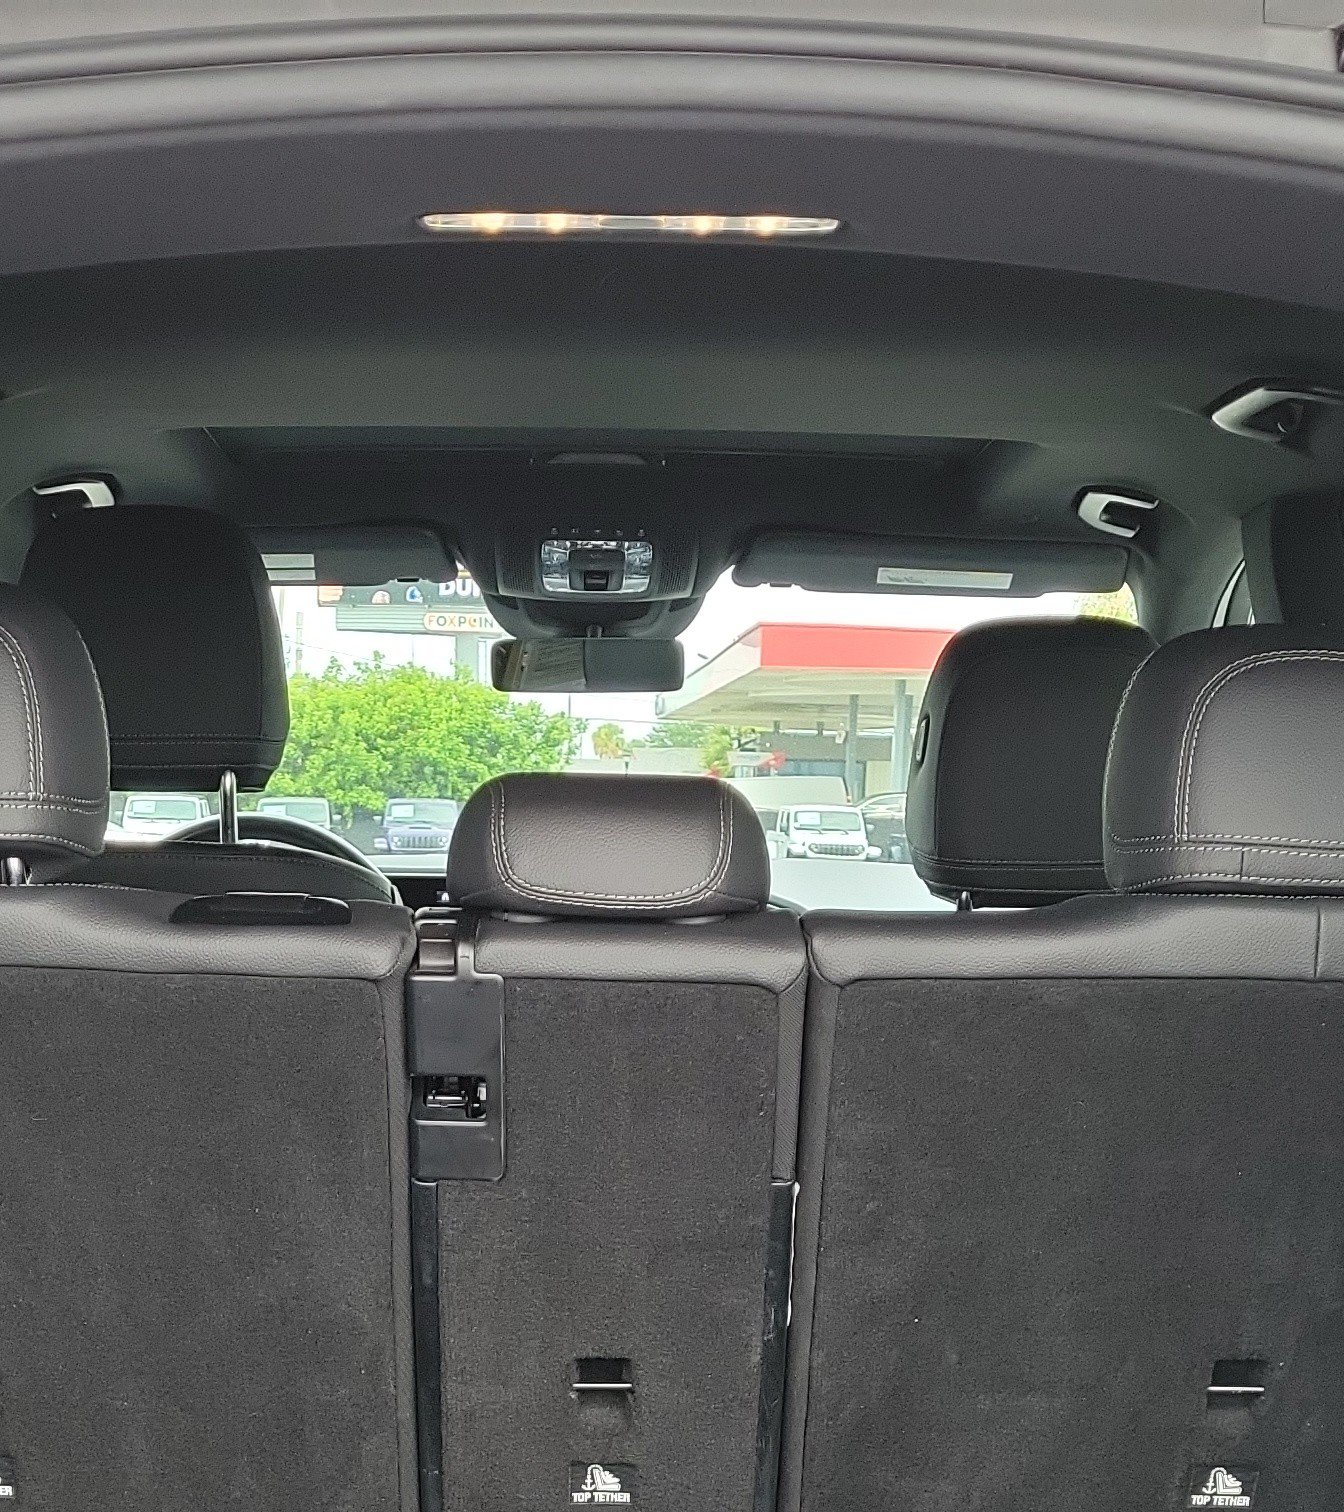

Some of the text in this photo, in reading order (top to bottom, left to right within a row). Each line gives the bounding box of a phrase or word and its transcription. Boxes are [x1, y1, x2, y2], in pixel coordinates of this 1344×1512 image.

[572, 1492, 631, 1503] TOP TETHER
[1191, 1494, 1251, 1507] TOP TETHER
